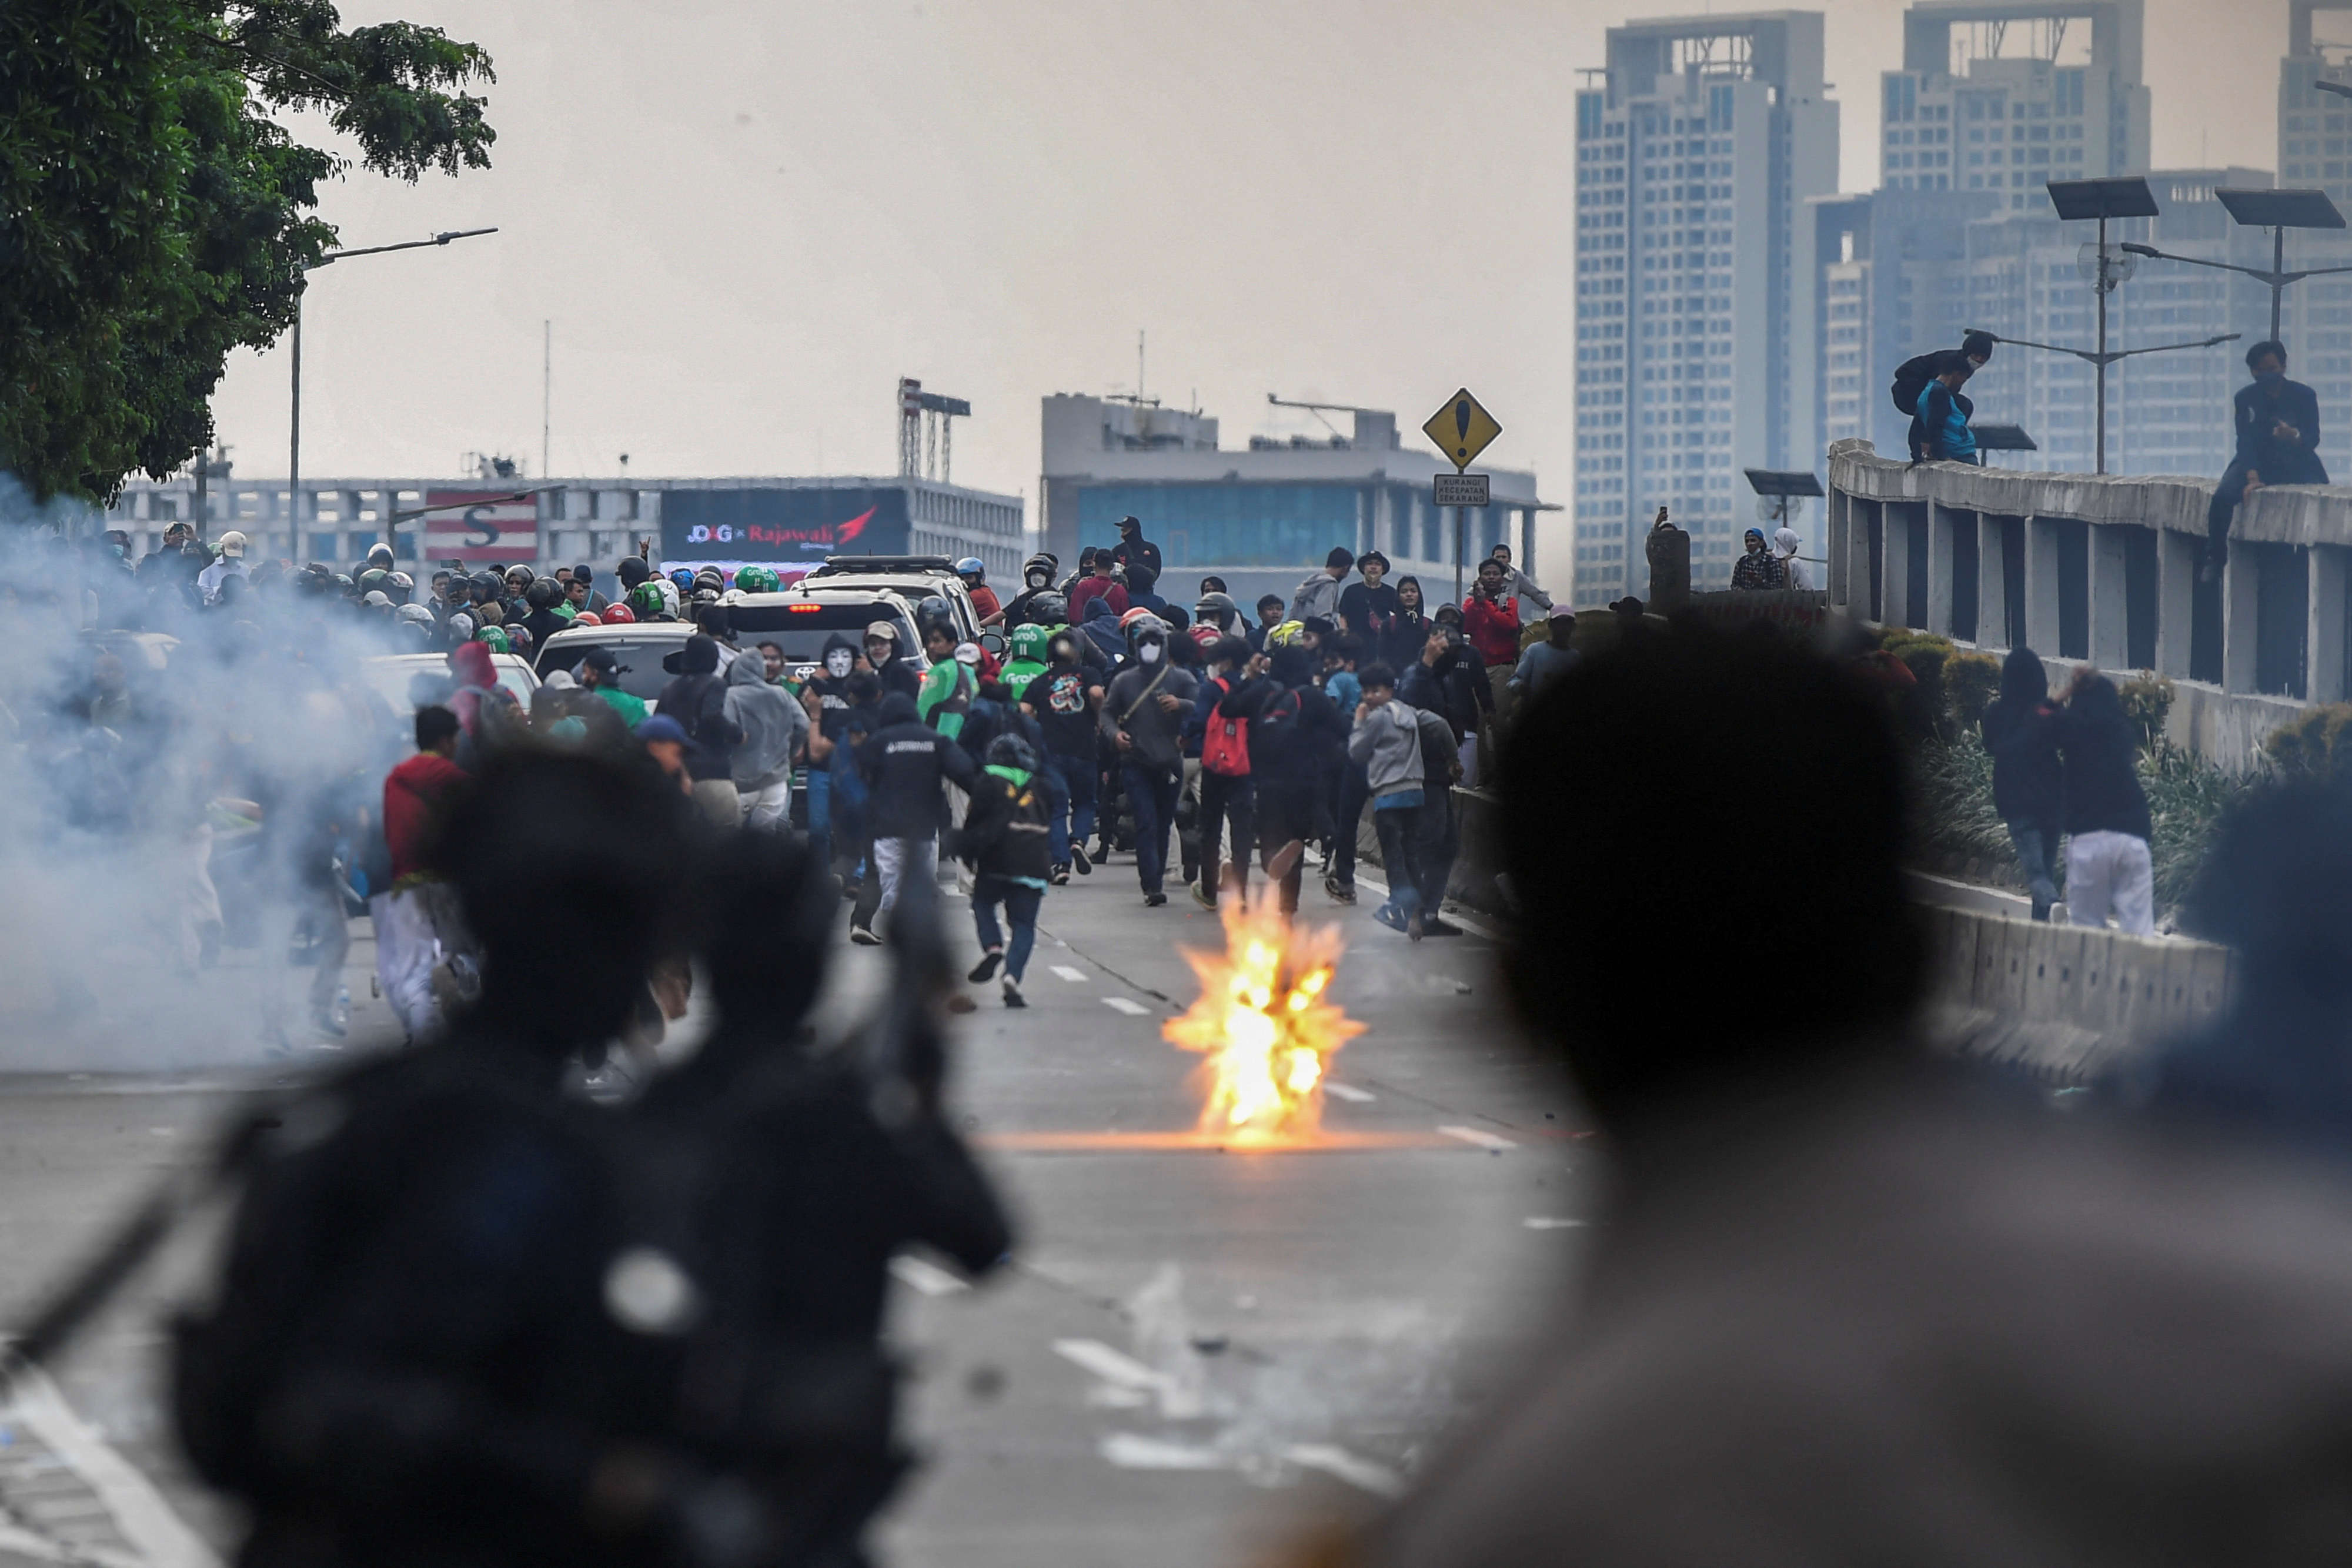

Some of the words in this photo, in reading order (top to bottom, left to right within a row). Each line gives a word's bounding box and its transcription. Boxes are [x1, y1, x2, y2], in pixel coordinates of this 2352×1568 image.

[1438, 487, 1485, 495] KECEPATAN
[463, 506, 500, 547] S
[748, 523, 834, 547] Rajawali
[1013, 631, 1038, 642] Grab
